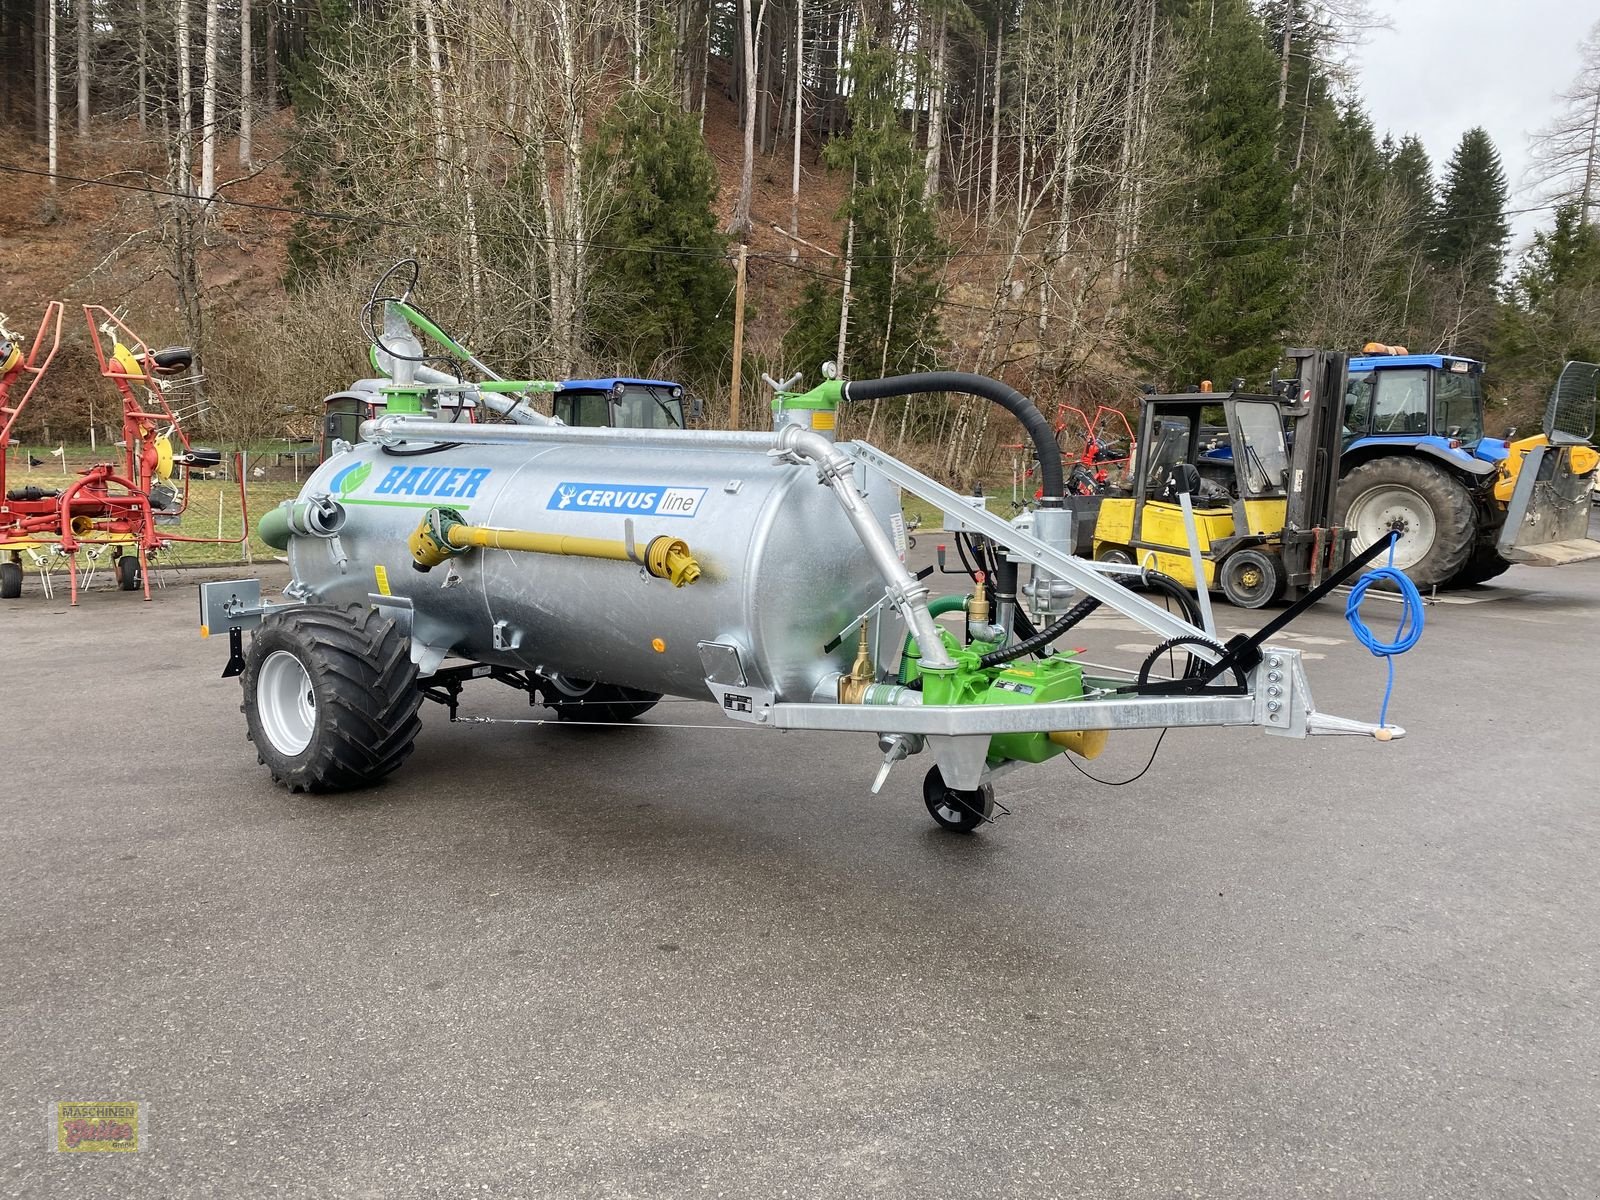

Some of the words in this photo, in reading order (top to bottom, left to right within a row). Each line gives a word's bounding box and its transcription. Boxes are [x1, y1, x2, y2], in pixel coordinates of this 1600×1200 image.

[374, 466, 492, 498] BAUER
[576, 489, 657, 509] CERVUS
[662, 492, 695, 512] line
